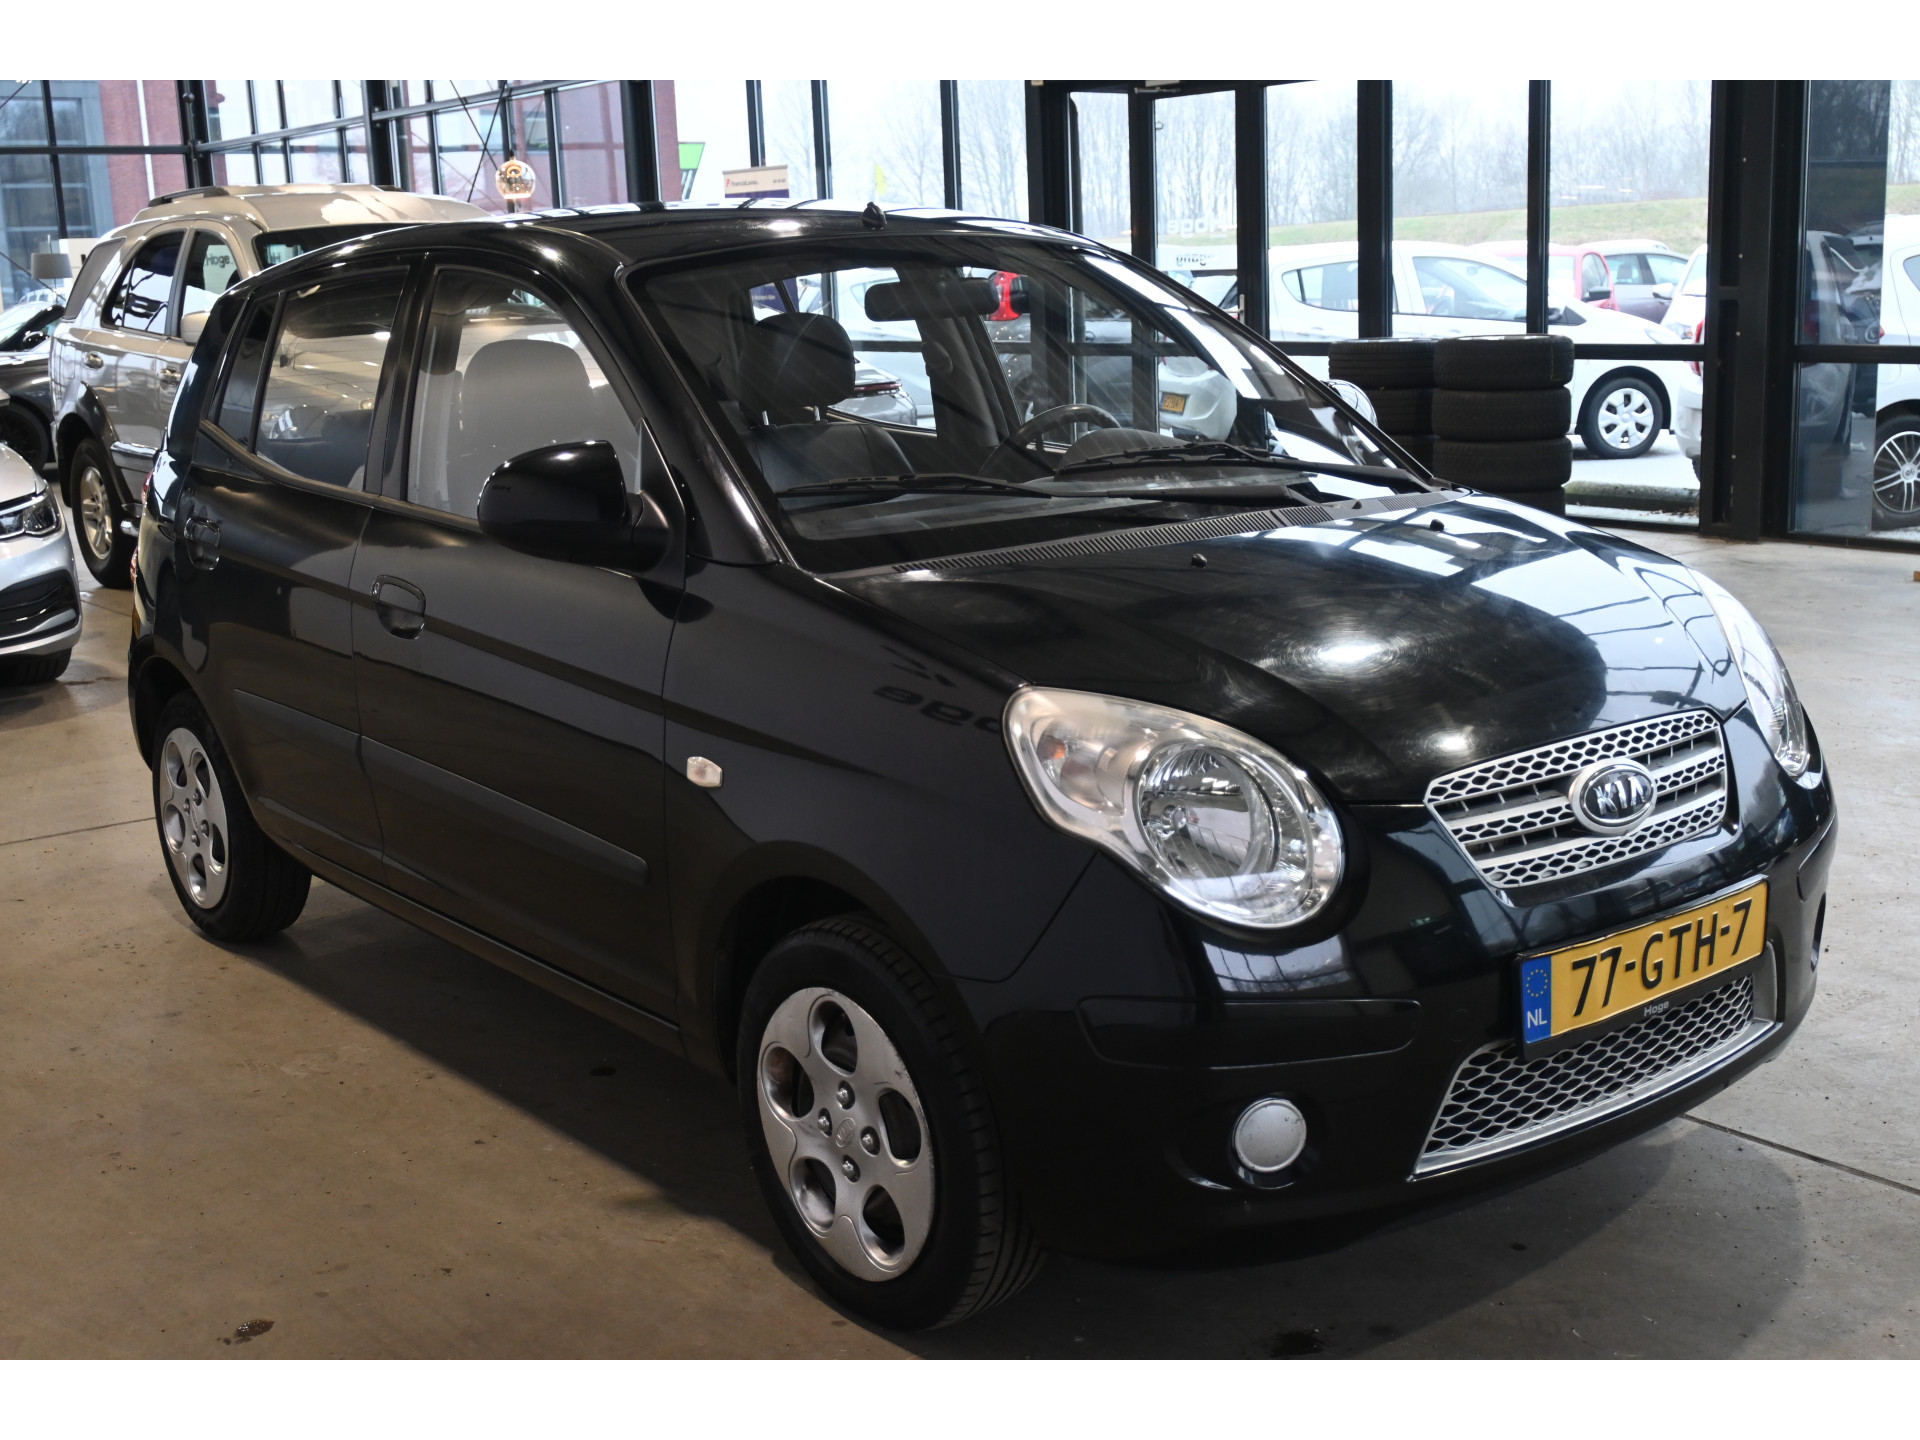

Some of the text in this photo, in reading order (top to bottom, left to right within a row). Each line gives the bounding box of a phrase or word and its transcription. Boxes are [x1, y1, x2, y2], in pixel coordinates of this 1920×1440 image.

[1592, 775, 1646, 815] KIA
[1570, 898, 1752, 1017] 77-GTH-7
[1526, 1007, 1548, 1029] NL
[1643, 1000, 1670, 1017] Hoge
